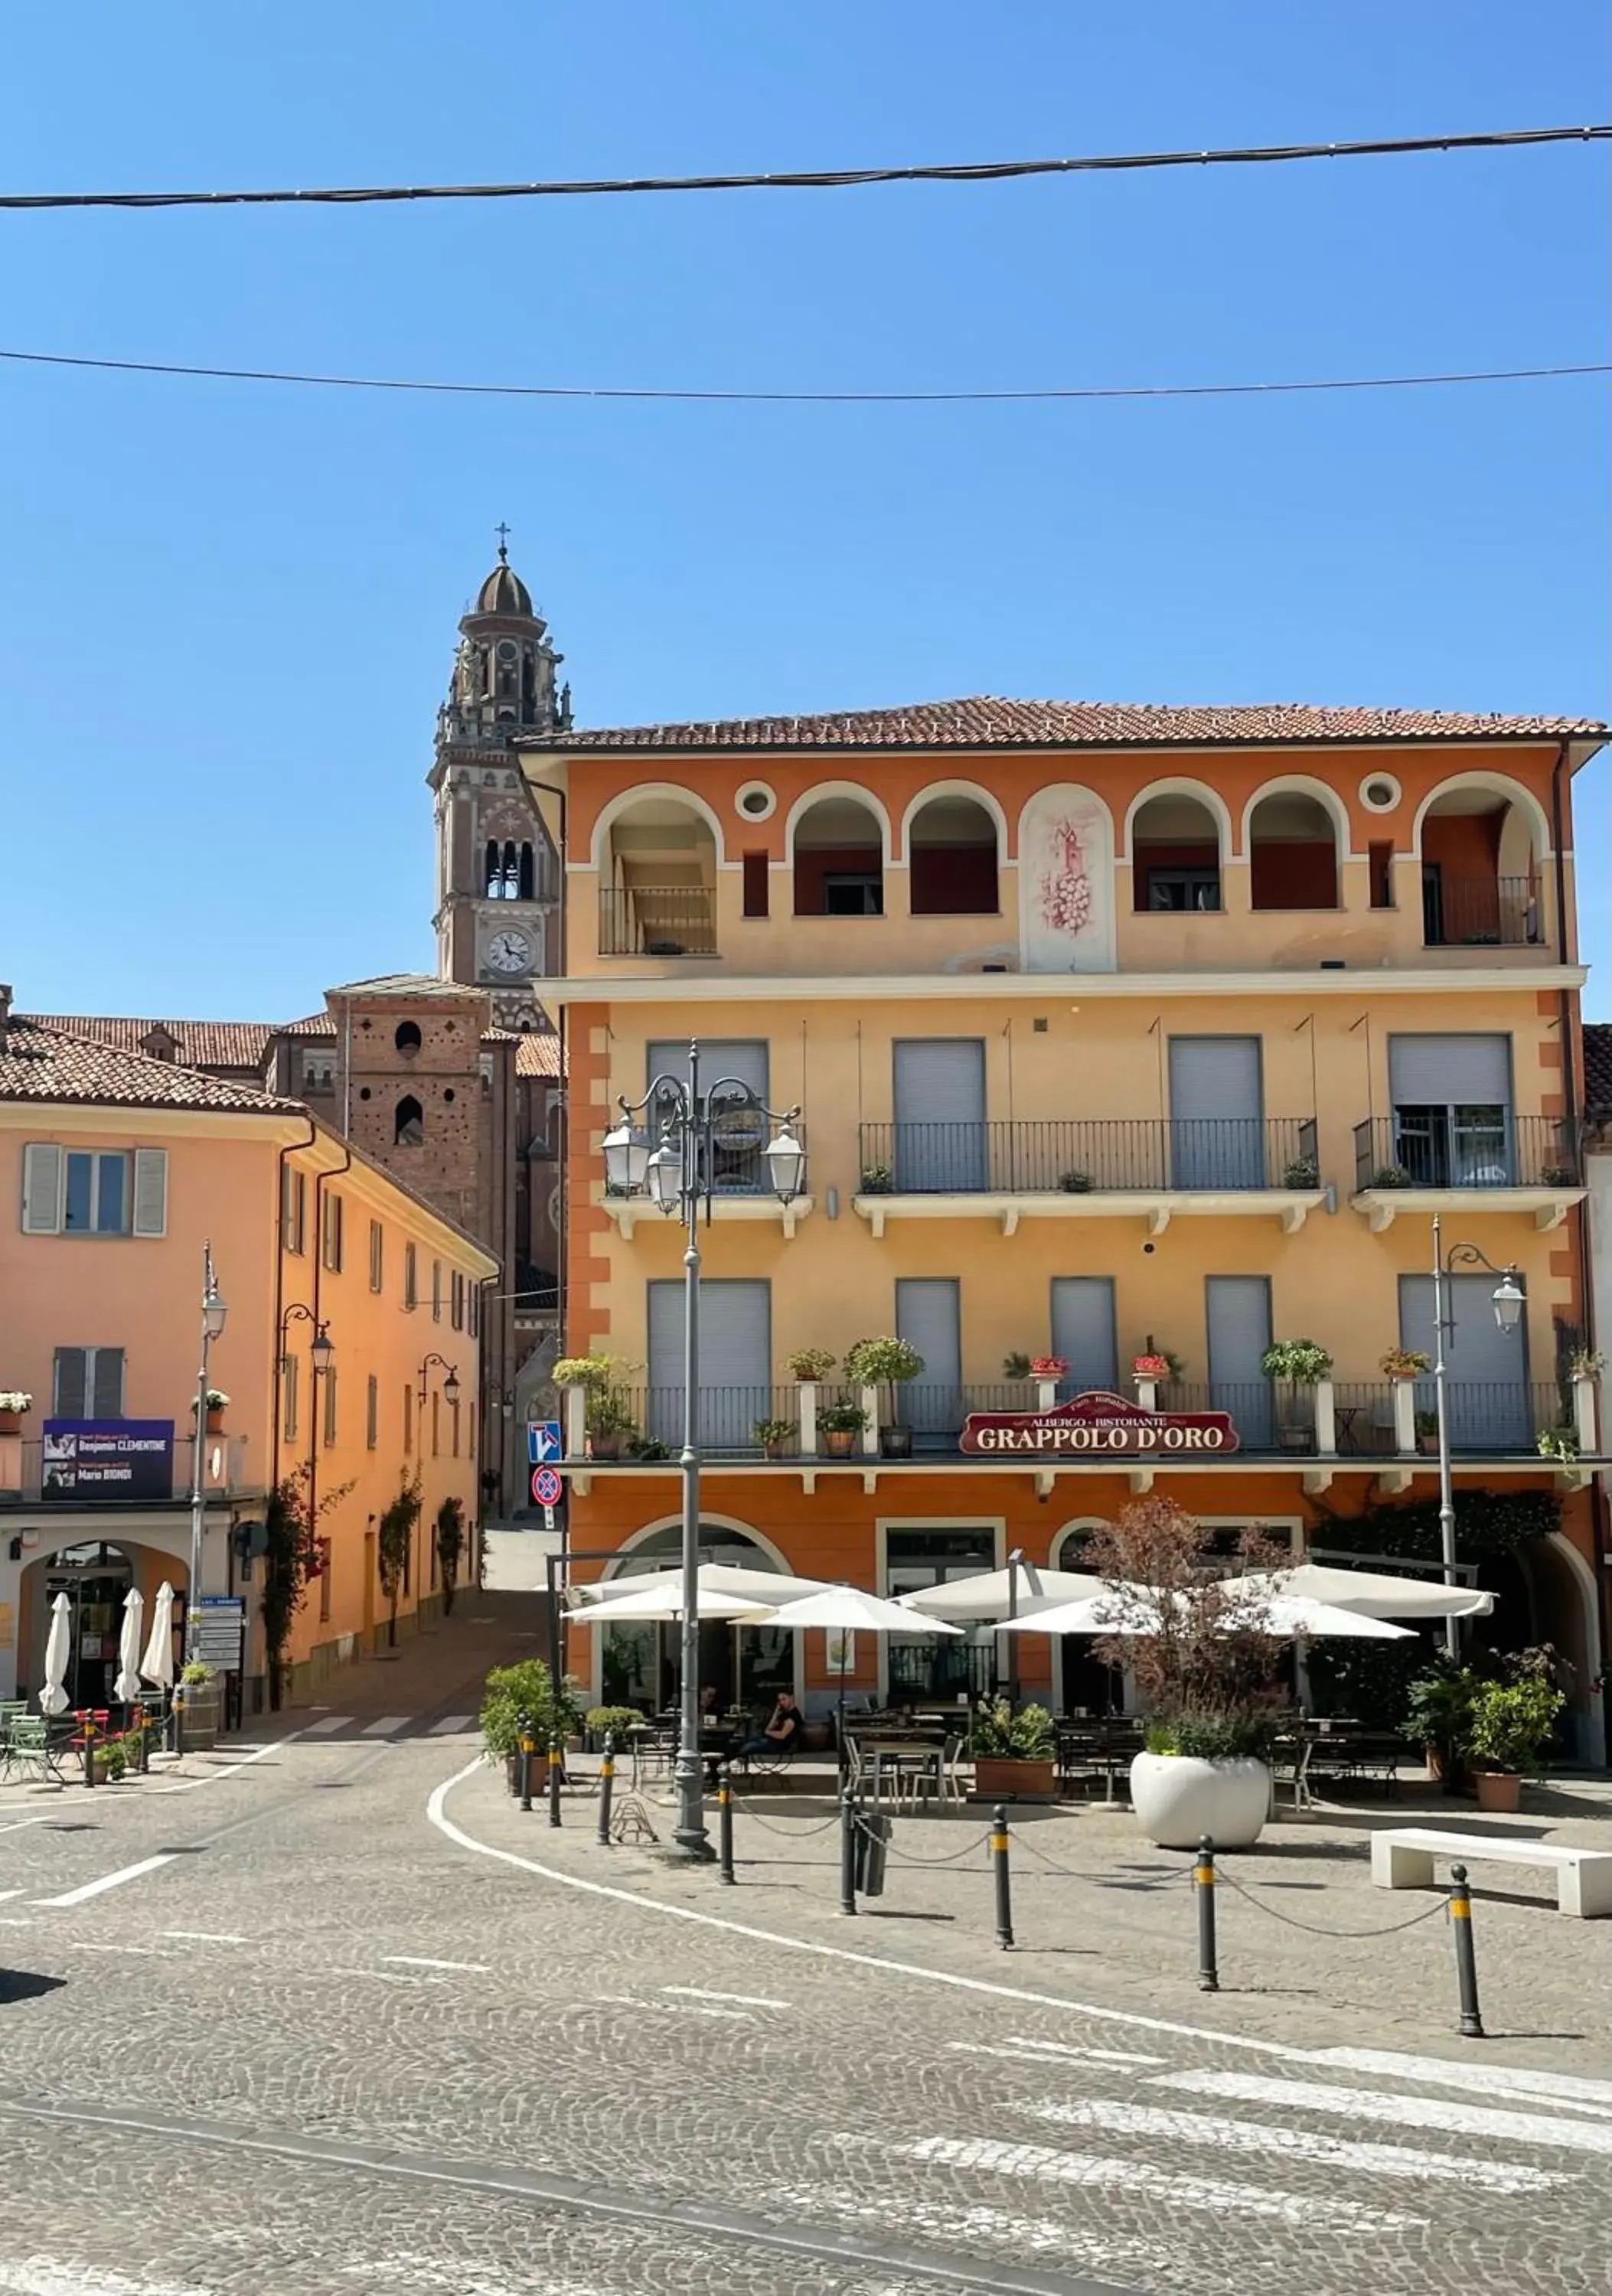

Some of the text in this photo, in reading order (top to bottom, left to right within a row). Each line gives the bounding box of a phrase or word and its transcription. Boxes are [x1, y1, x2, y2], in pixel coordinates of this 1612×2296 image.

[1030, 1417, 1086, 1427] ALBERGO
[1095, 1417, 1167, 1427] RISTORANTE
[977, 1427, 1224, 1450] GRAPPOLO D'ORO
[79, 1440, 166, 1453] Benjamin CLEMENTINE
[78, 1469, 132, 1480] Mario BIONDI
